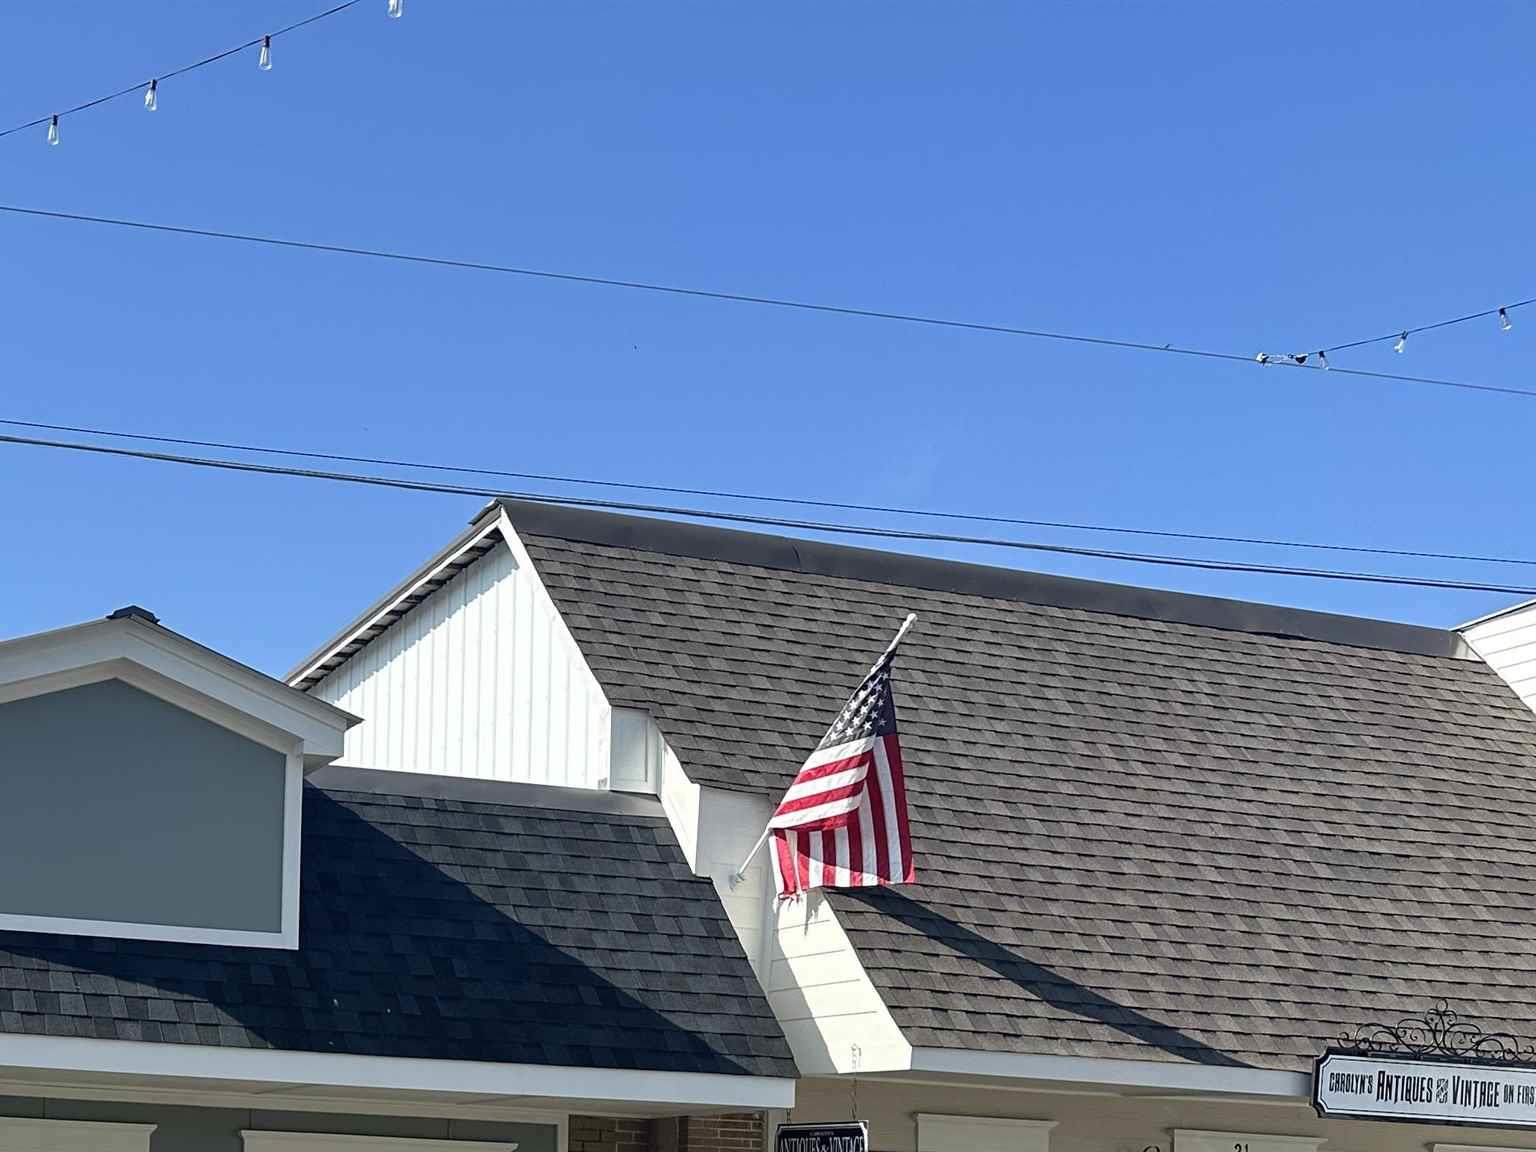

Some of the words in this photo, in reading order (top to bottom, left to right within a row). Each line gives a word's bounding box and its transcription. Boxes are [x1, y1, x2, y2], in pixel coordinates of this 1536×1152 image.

[1329, 1072, 1373, 1094] CAROLYN'S
[1376, 1070, 1433, 1104] ANTIQUES
[1452, 1075, 1500, 1109] VINTAGE
[1503, 1084, 1514, 1103] ON
[1517, 1085, 1536, 1106] FIRS
